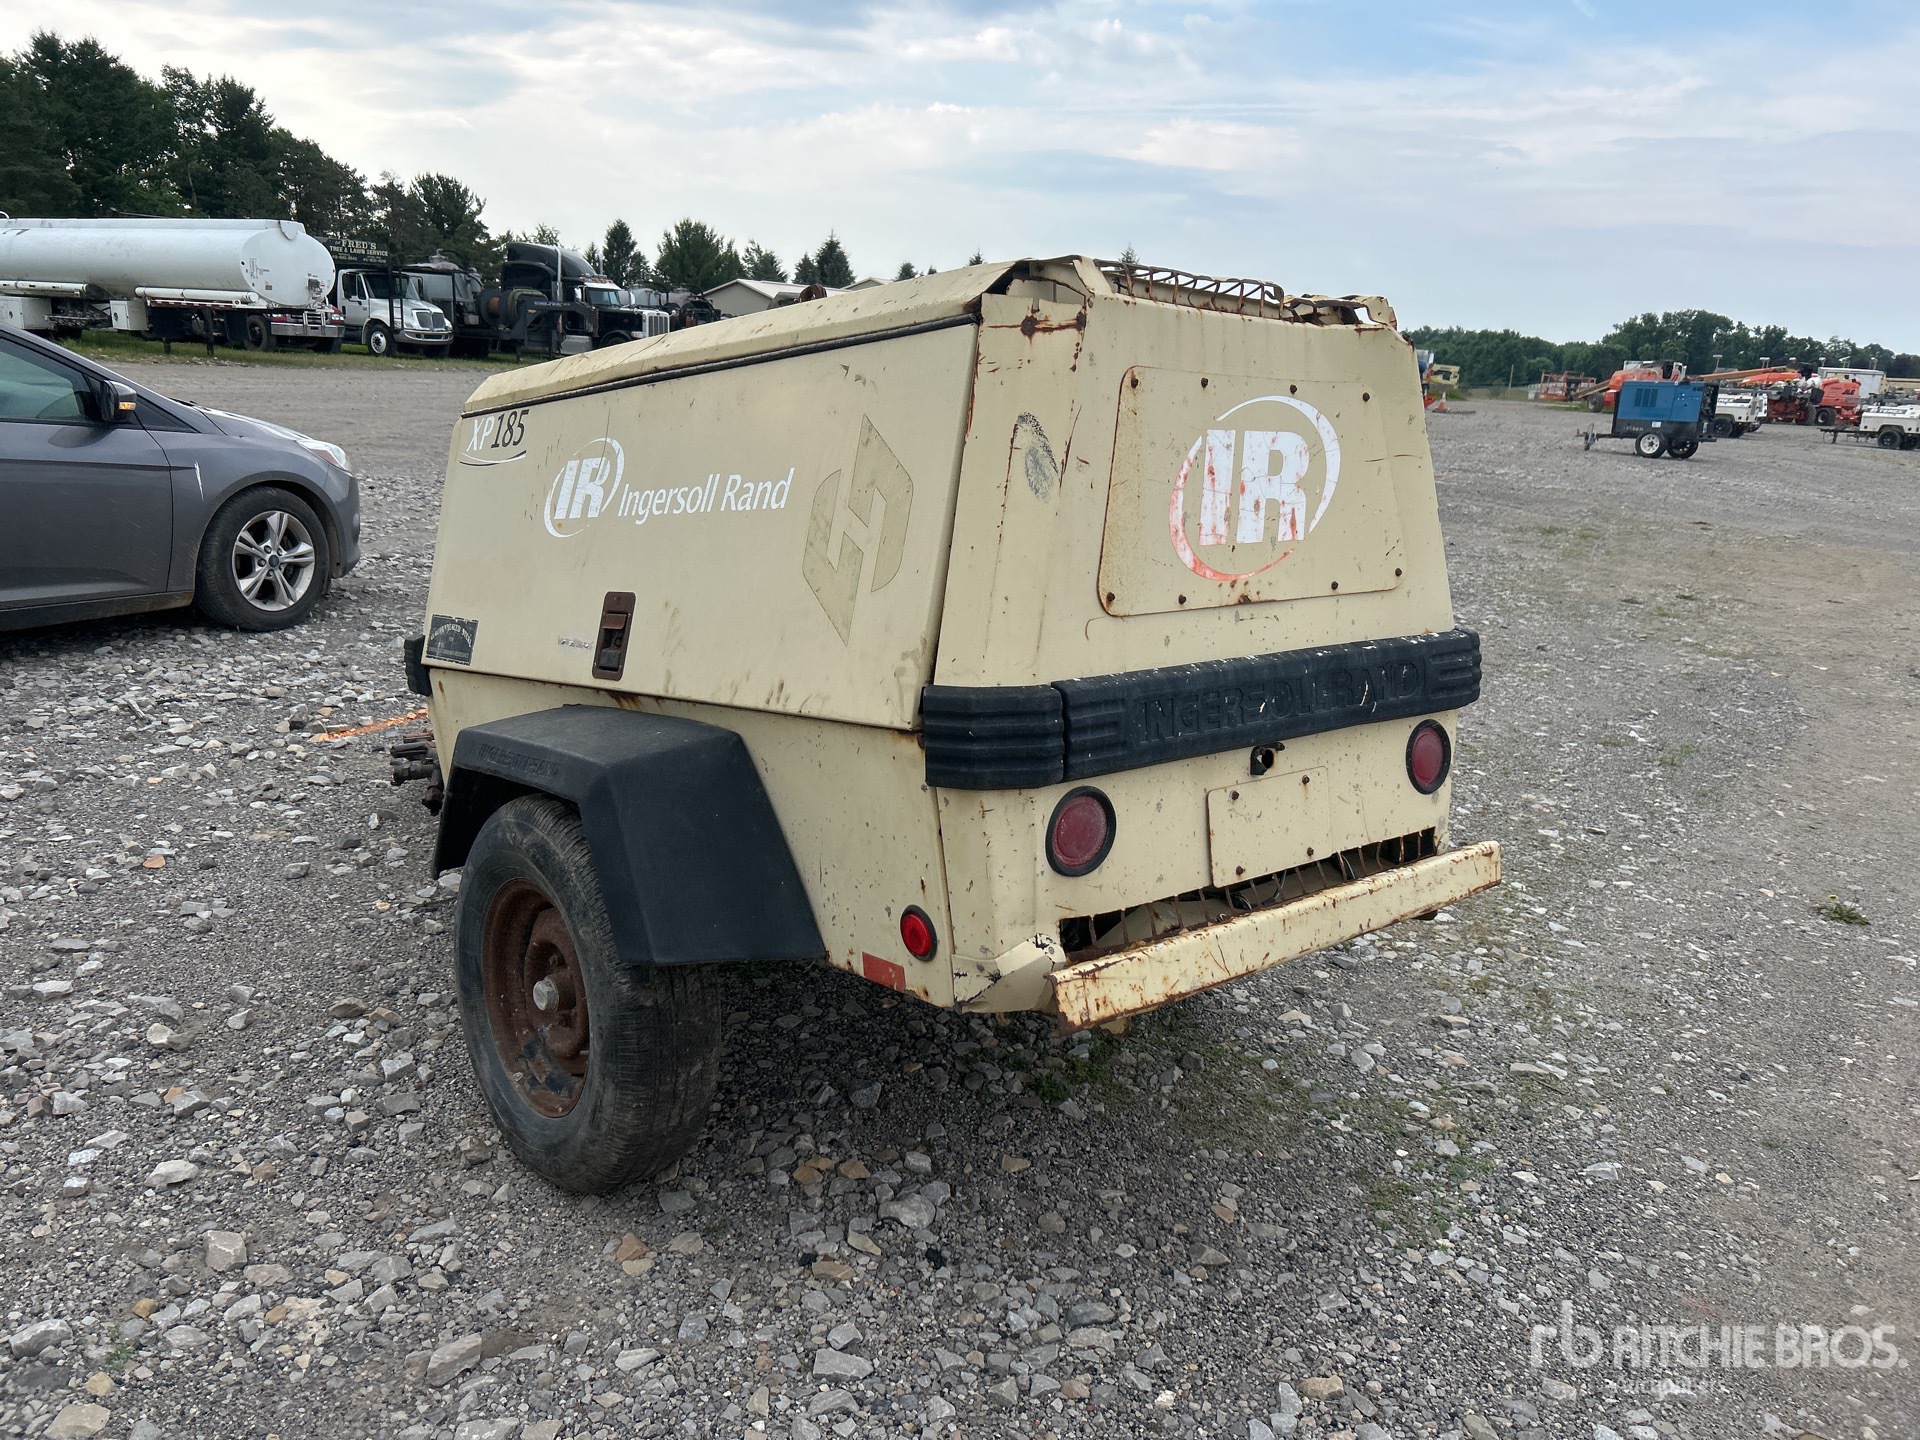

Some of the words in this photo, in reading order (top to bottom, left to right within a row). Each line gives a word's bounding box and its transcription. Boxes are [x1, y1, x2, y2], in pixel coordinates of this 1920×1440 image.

[342, 239, 377, 250] FRED'S
[366, 249, 389, 257] SERVICE
[554, 457, 611, 520] IR
[617, 473, 721, 525] Ingersoll
[720, 467, 796, 512] Rand
[1199, 429, 1310, 547] IR
